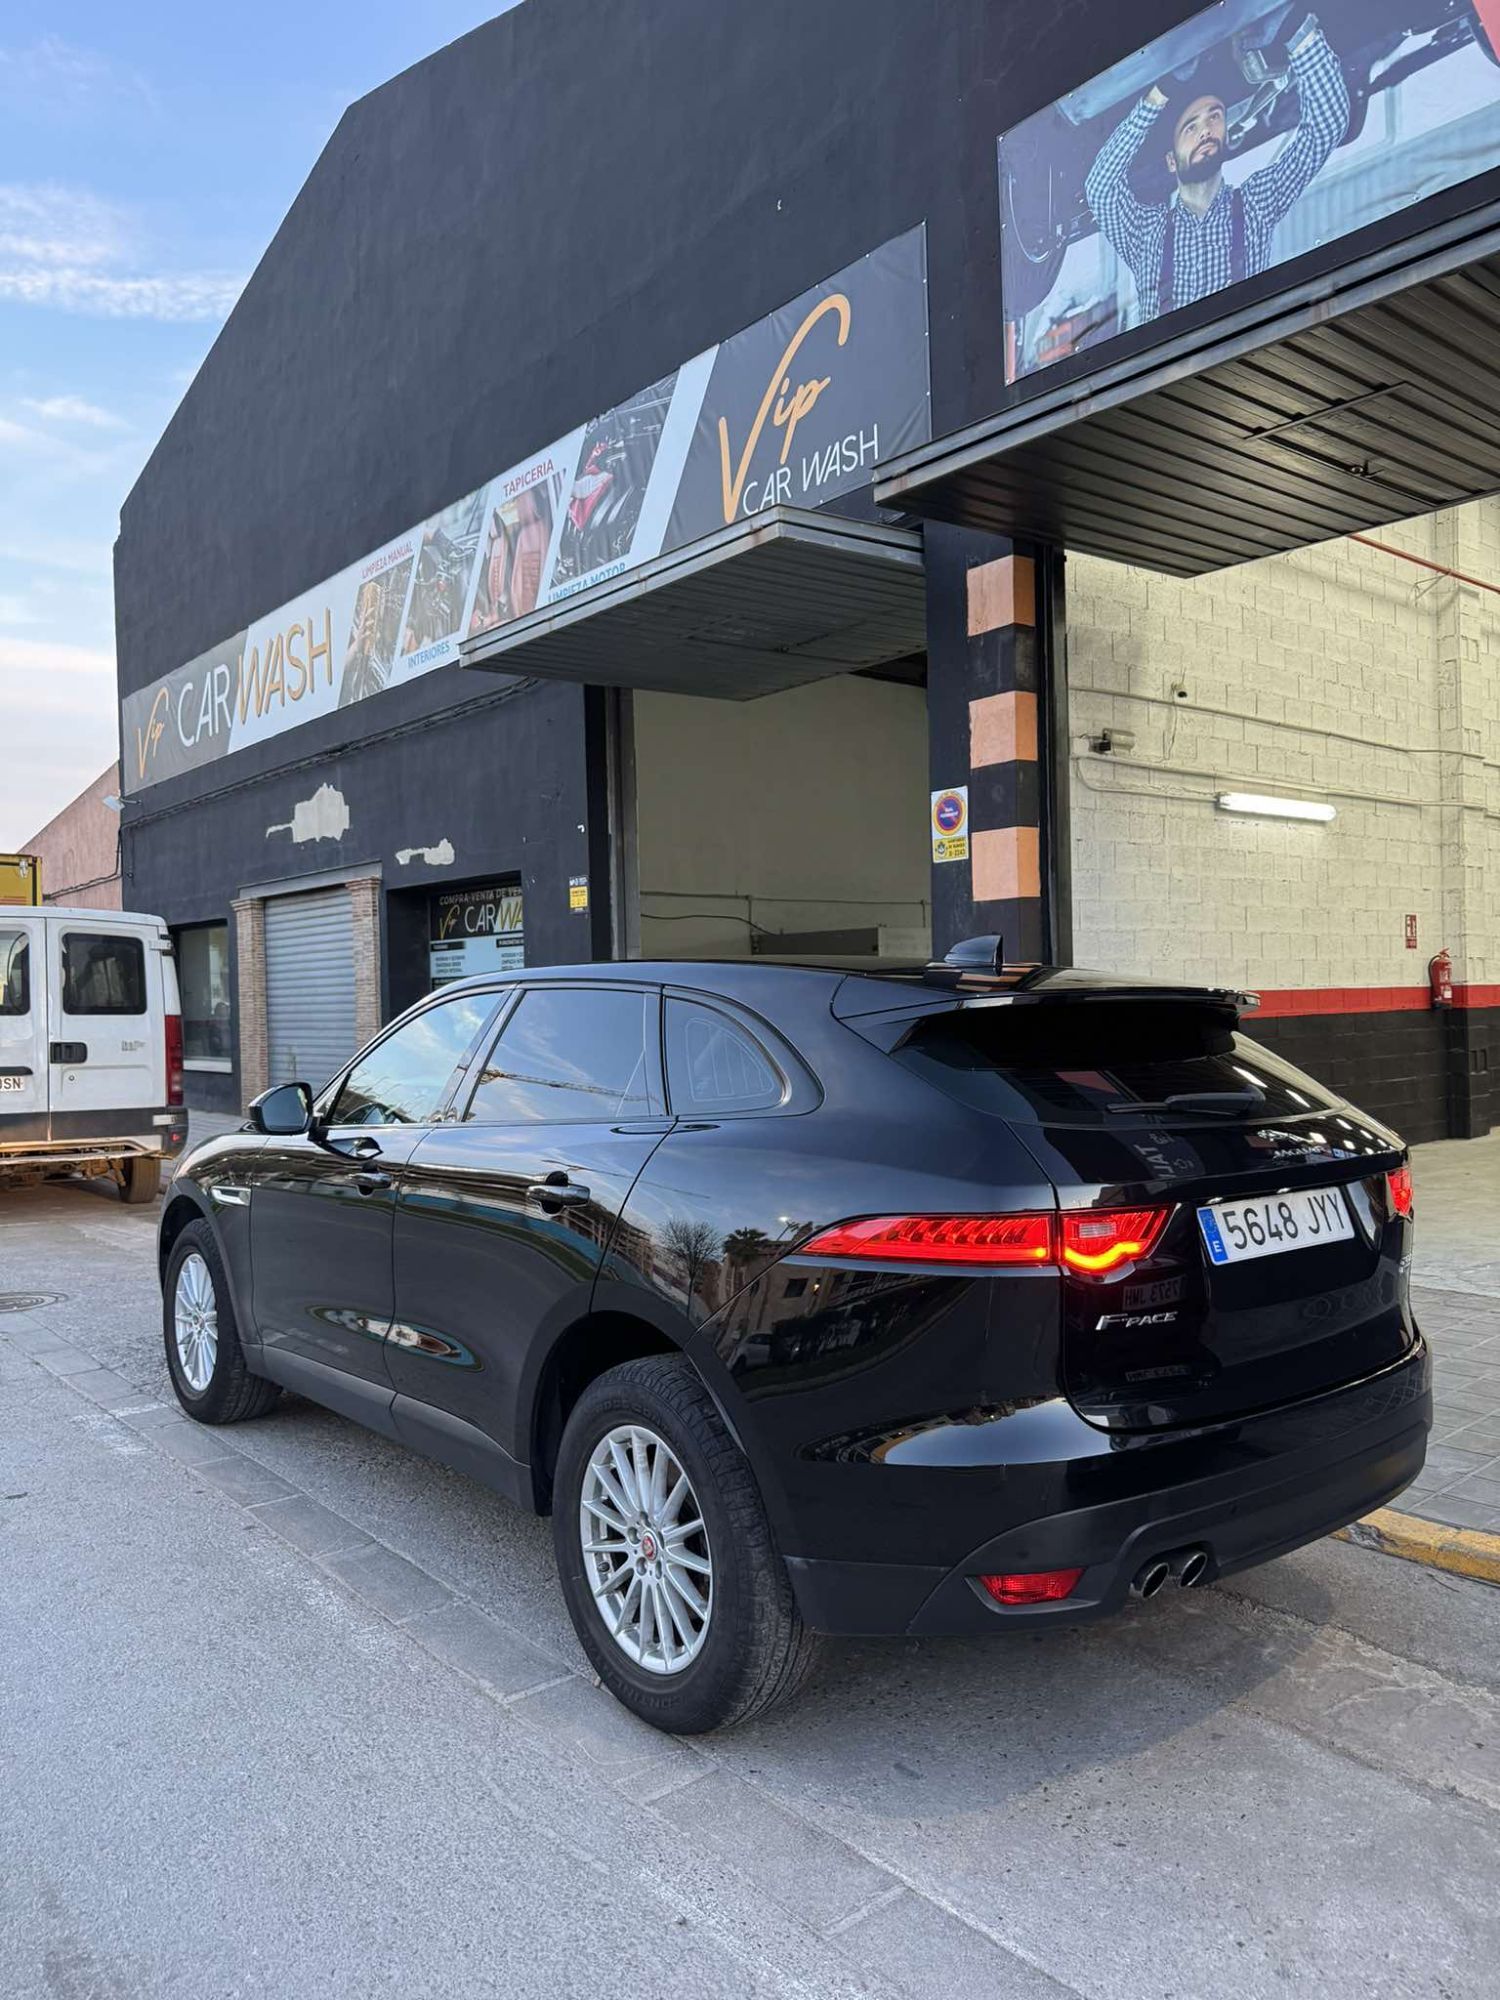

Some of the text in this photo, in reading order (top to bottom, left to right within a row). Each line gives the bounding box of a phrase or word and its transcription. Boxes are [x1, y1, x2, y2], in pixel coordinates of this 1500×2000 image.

[718, 293, 851, 523] Vip
[502, 458, 555, 498] TAPICERIA
[742, 423, 879, 515] CAR WASH
[388, 541, 414, 565] MANUAL
[589, 562, 626, 586] MOTOR
[408, 641, 450, 670] INTERIORES
[137, 607, 333, 779] Vip CAR WASH
[464, 903, 496, 933] CAR
[1223, 1190, 1346, 1250] 5648 JYY
[1211, 1240, 1223, 1254] E
